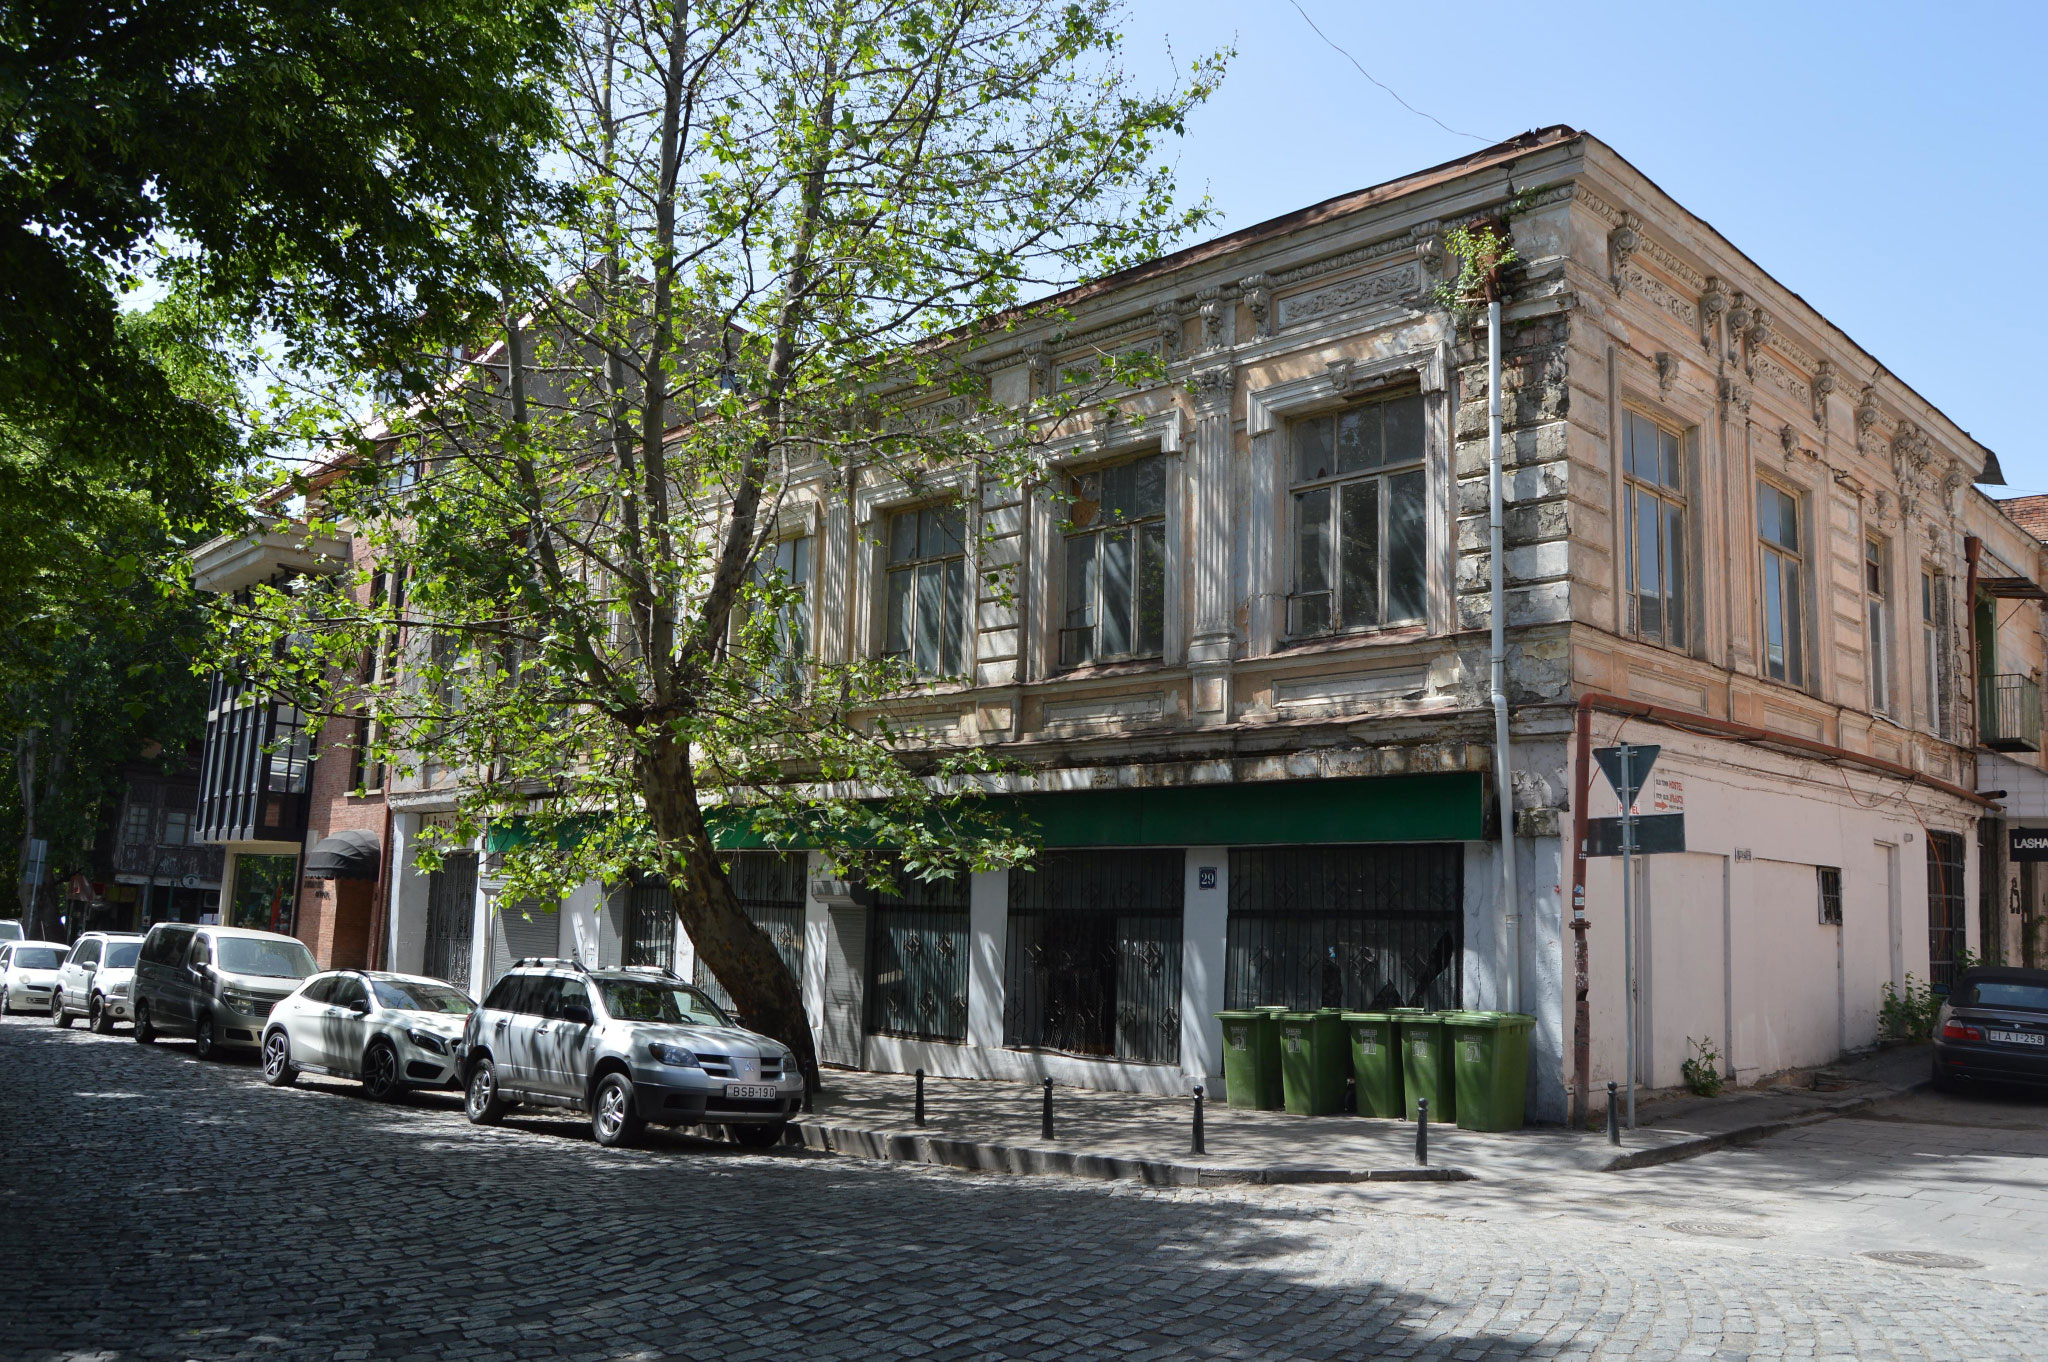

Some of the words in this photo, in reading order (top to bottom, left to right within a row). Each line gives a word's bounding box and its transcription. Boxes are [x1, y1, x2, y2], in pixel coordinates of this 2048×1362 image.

[2014, 838, 2048, 849] LASHA
[1201, 872, 1215, 885] 29
[733, 1086, 775, 1098] BSB-190
